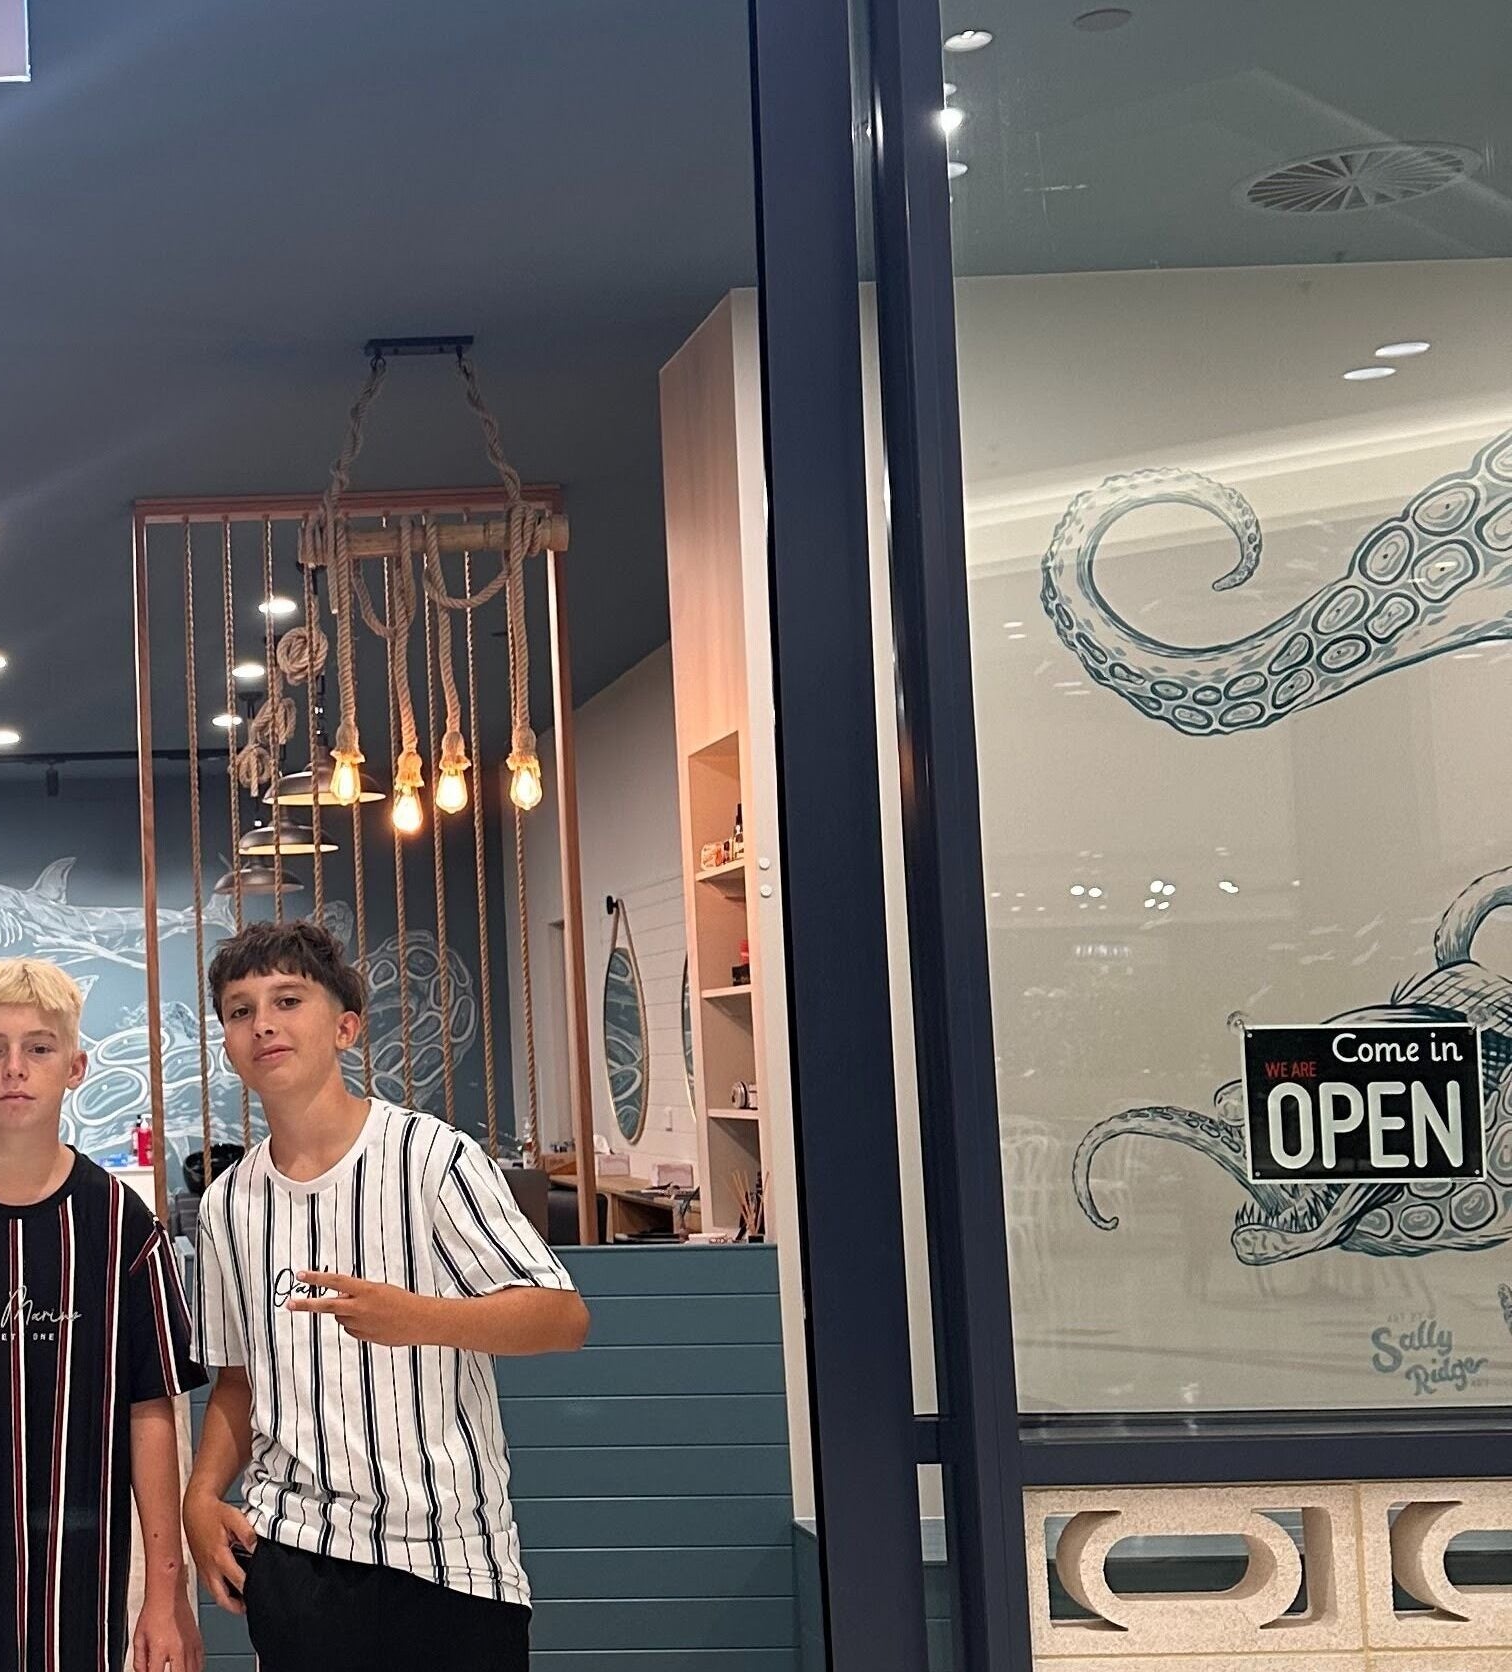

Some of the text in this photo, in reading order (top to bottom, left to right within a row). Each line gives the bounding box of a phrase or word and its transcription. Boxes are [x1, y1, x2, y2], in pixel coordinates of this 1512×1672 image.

[1331, 1031, 1464, 1063] Come in
[1265, 1060, 1317, 1079] WE ARE
[1266, 1080, 1464, 1170] OPEN
[1371, 1319, 1454, 1374] Sally
[1405, 1356, 1489, 1397] Ridger
